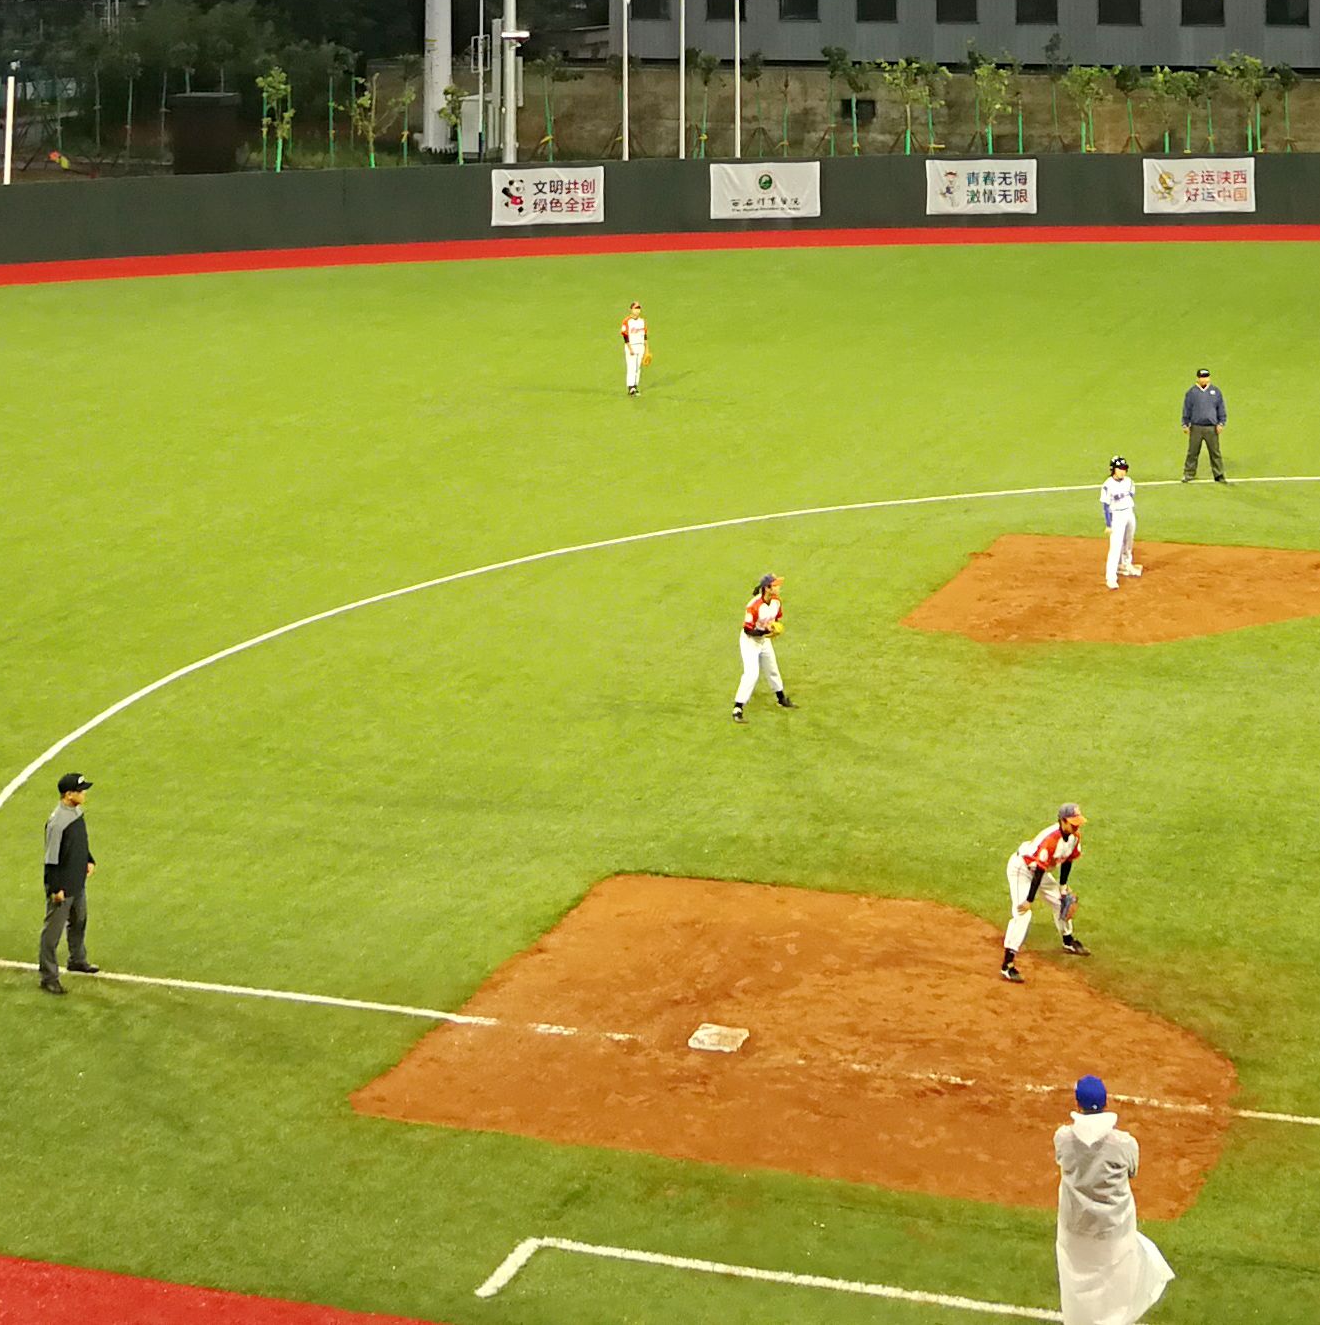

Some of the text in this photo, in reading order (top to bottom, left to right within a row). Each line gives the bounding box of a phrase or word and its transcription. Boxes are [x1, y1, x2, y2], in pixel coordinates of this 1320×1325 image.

[966, 171, 1028, 186] 青春无悔
[1185, 170, 1247, 185] 全运陕西
[533, 178, 596, 195] 文明共创
[966, 188, 1028, 204] 激情无限
[1185, 187, 1247, 202] 好运中国
[533, 197, 596, 213] 绿色全运
